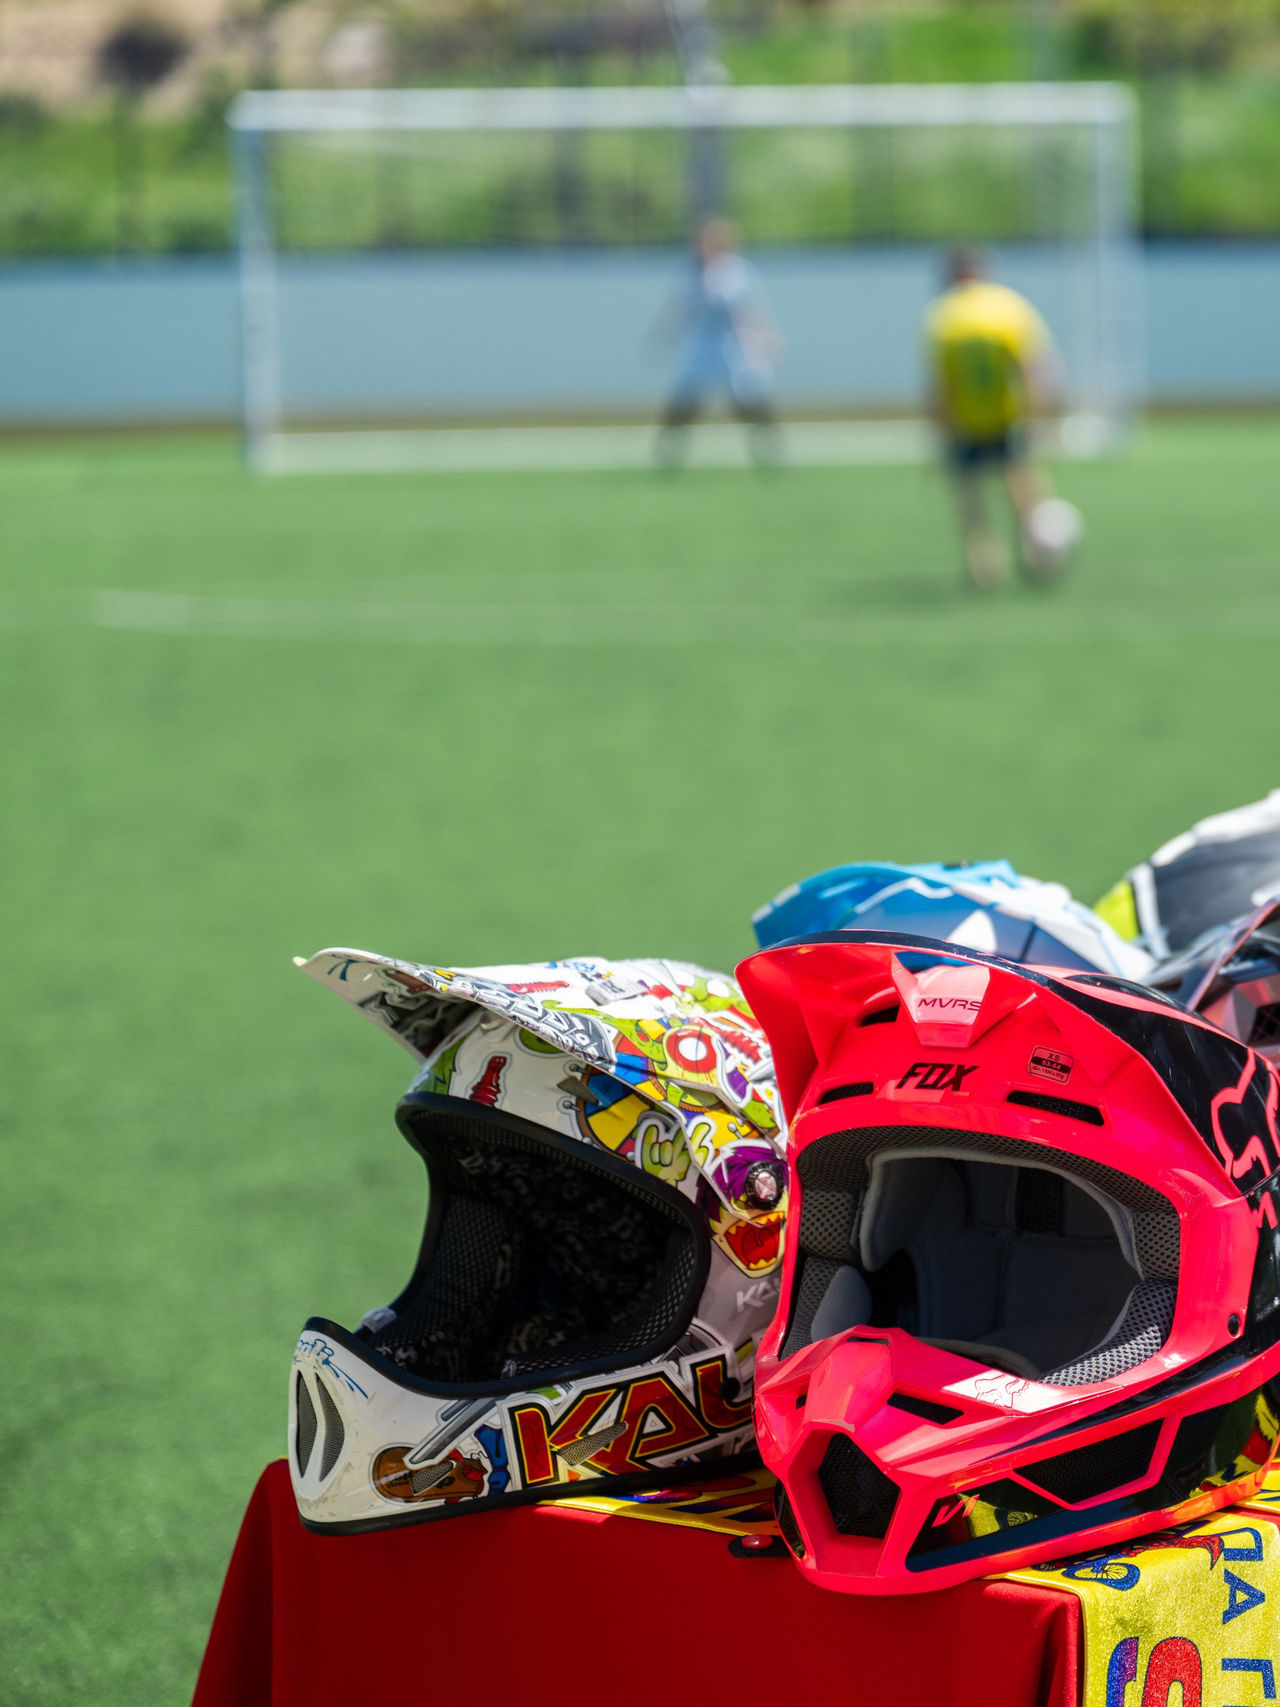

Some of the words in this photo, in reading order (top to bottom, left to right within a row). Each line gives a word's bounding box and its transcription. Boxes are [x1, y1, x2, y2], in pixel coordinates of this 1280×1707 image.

[917, 998, 982, 1011] MVRS
[1047, 1052, 1061, 1062] XS
[894, 1062, 981, 1092] FOX
[508, 1354, 757, 1488] KAL
